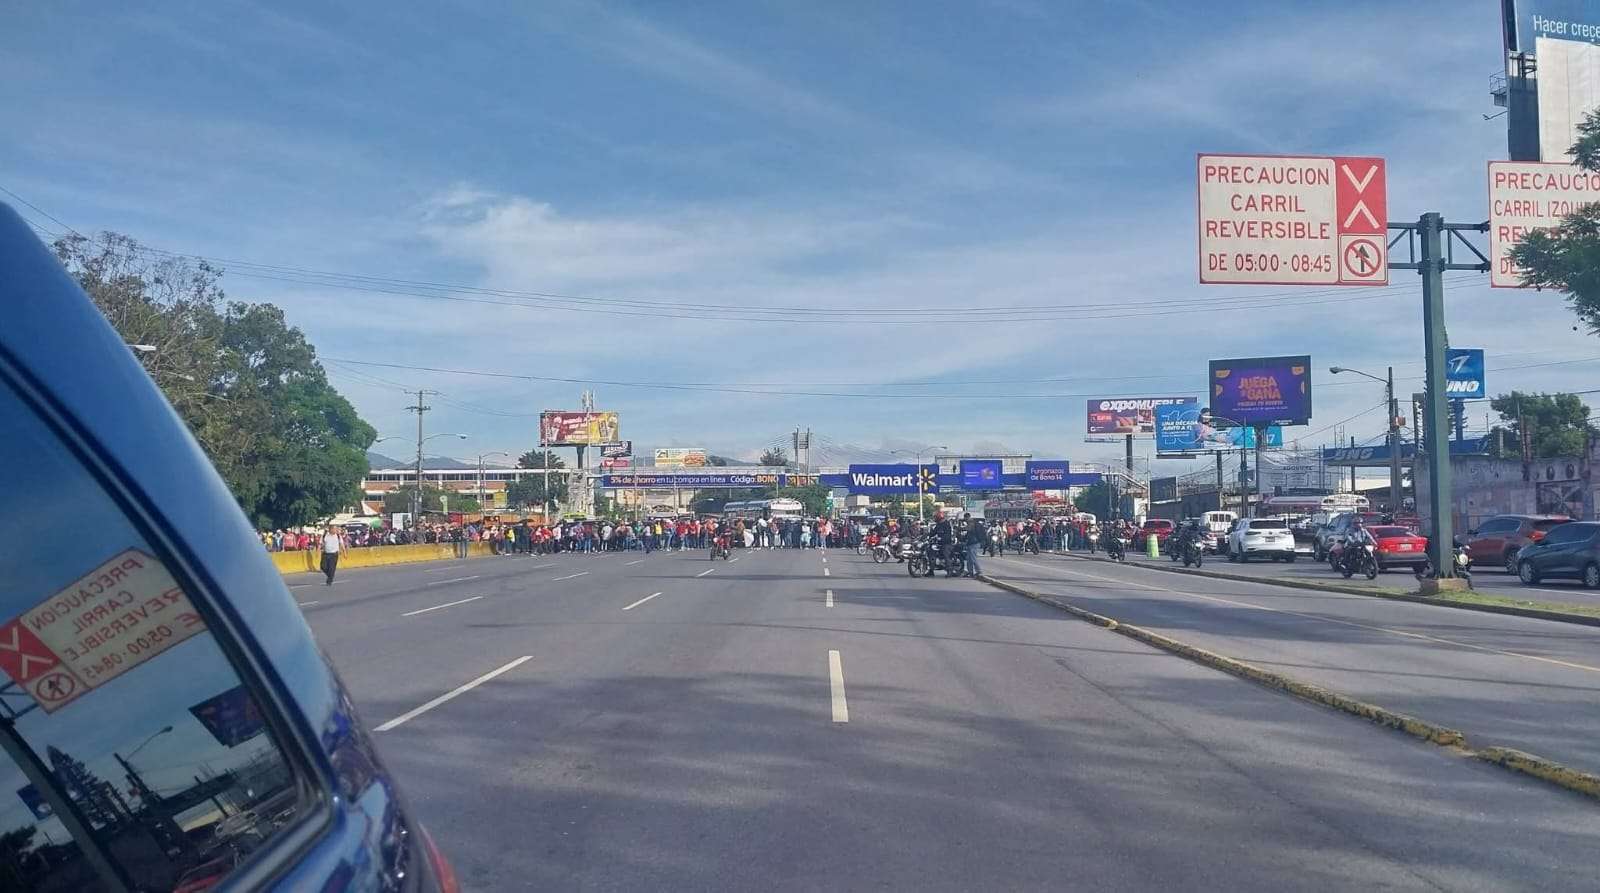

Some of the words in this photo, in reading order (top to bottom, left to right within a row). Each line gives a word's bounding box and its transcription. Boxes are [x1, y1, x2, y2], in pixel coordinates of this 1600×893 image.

[1533, 15, 1568, 34] Hacer
[1205, 165, 1330, 185] PRECAUCION
[1231, 194, 1306, 213] CARRIL
[1494, 199, 1544, 217] CARRIL
[1205, 220, 1331, 240] REVERSIBLE
[1208, 253, 1227, 272] DE
[610, 476, 621, 484] 5%
[622, 476, 632, 484] de
[632, 476, 656, 484] ahorro
[674, 477, 700, 485] compra
[852, 473, 913, 487] Walmart
